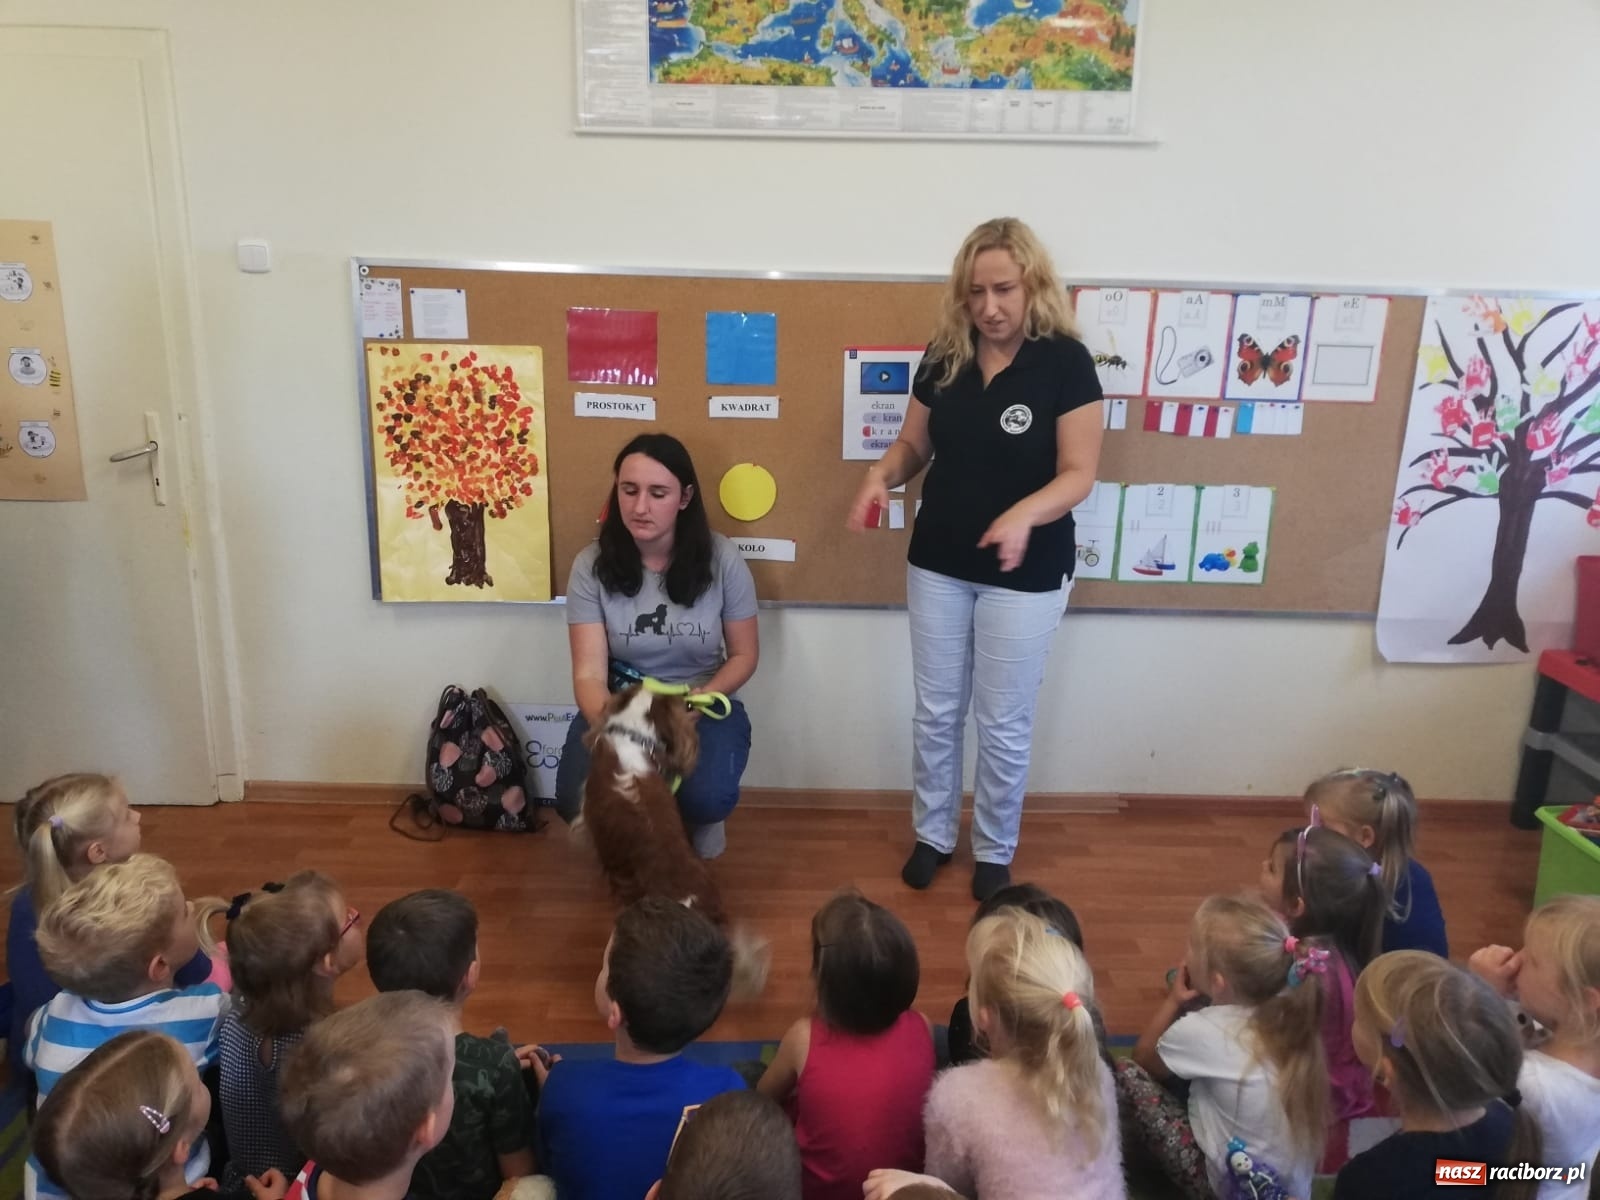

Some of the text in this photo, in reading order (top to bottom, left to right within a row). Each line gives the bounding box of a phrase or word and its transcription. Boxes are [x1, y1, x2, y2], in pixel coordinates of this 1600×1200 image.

[1105, 290, 1123, 302] oO
[1186, 294, 1203, 305] aA
[1262, 296, 1286, 307] mM
[586, 401, 646, 412] PROSTOKĄT
[721, 403, 771, 412] KWADRAT
[871, 401, 895, 410] ekran
[870, 440, 892, 449] ekra
[1156, 486, 1165, 496] 2
[1232, 487, 1241, 498] 3
